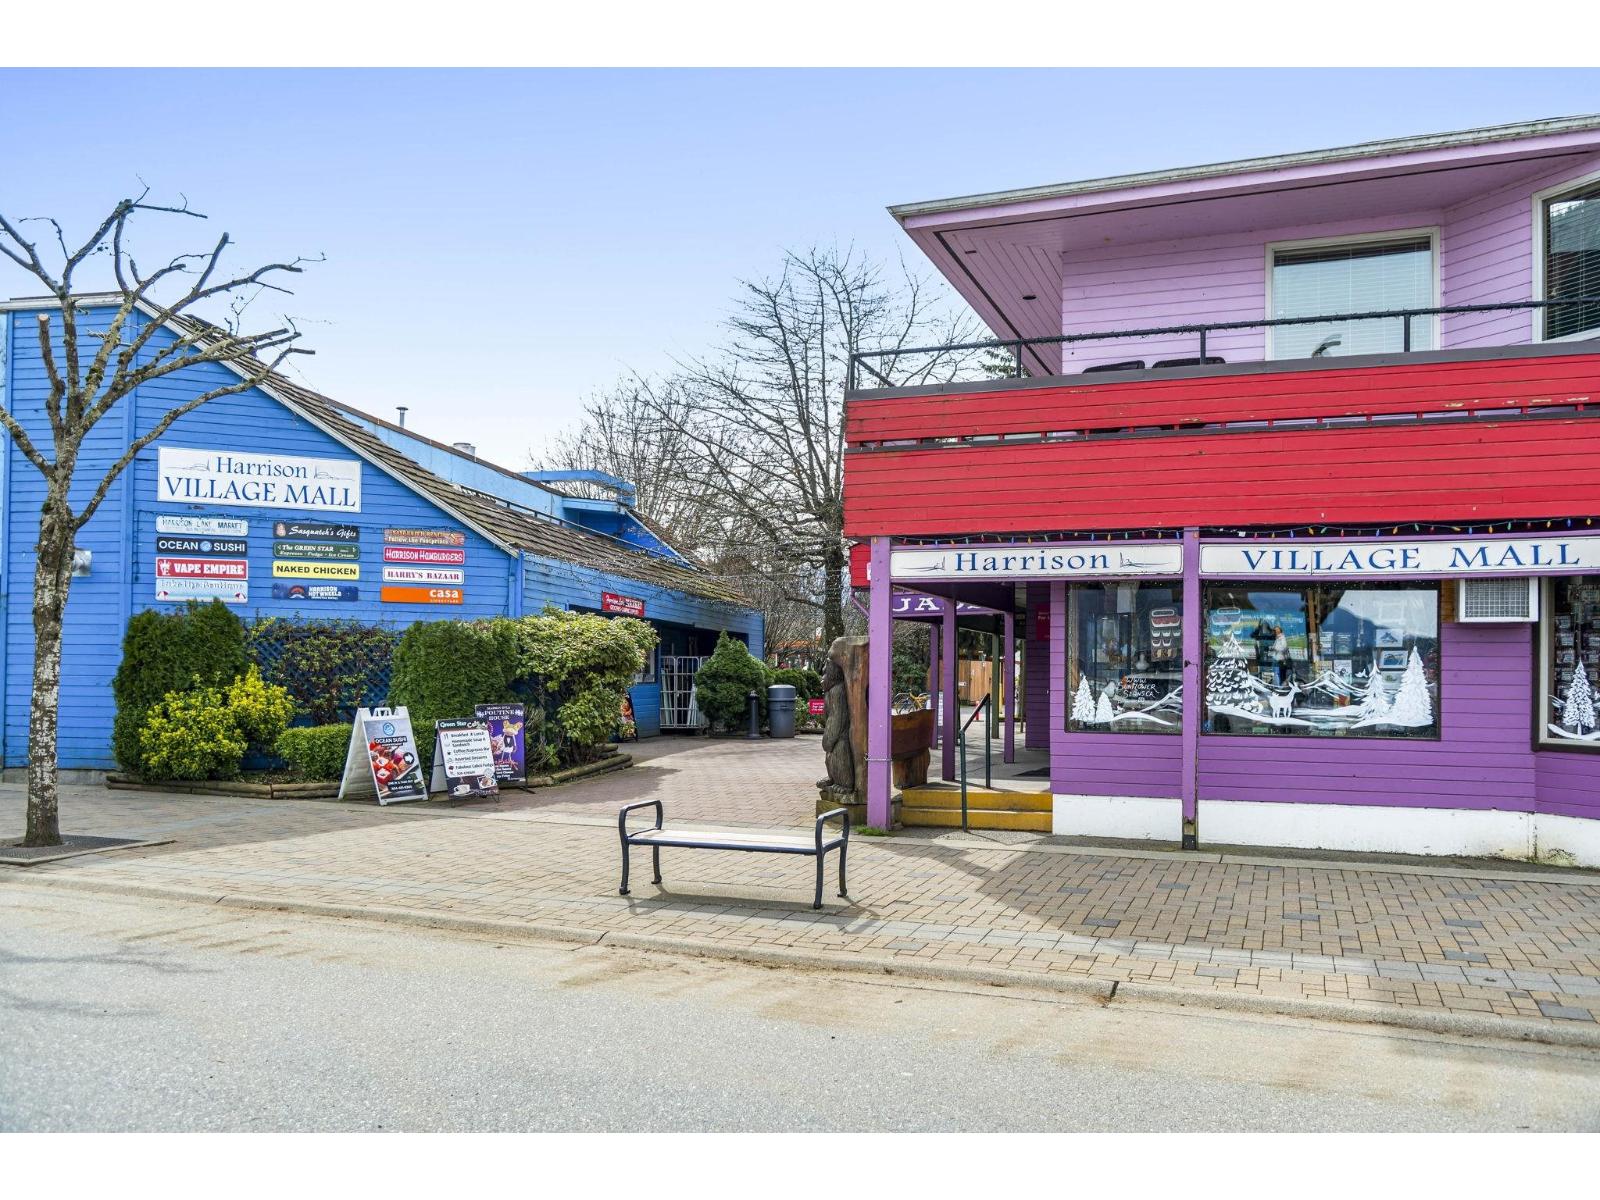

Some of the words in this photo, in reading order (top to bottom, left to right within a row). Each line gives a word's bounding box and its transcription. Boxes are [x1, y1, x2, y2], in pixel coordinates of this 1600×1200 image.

[216, 456, 308, 479] Harrison
[164, 476, 276, 502] VILLAGE
[283, 484, 356, 507] MALL
[288, 526, 334, 537] Sasquatch's
[336, 528, 357, 539] Gifts
[158, 541, 199, 550] OCEAN
[213, 543, 246, 552] SUSHI
[954, 550, 1110, 572] Harrison
[1241, 547, 1421, 571] VILLAGE
[1448, 543, 1581, 568] MALL
[173, 563, 201, 574] VAPE
[203, 564, 245, 575] EMPIRE
[276, 565, 310, 573] NAKED
[313, 567, 357, 575] CHICKEN
[429, 589, 459, 598] casa
